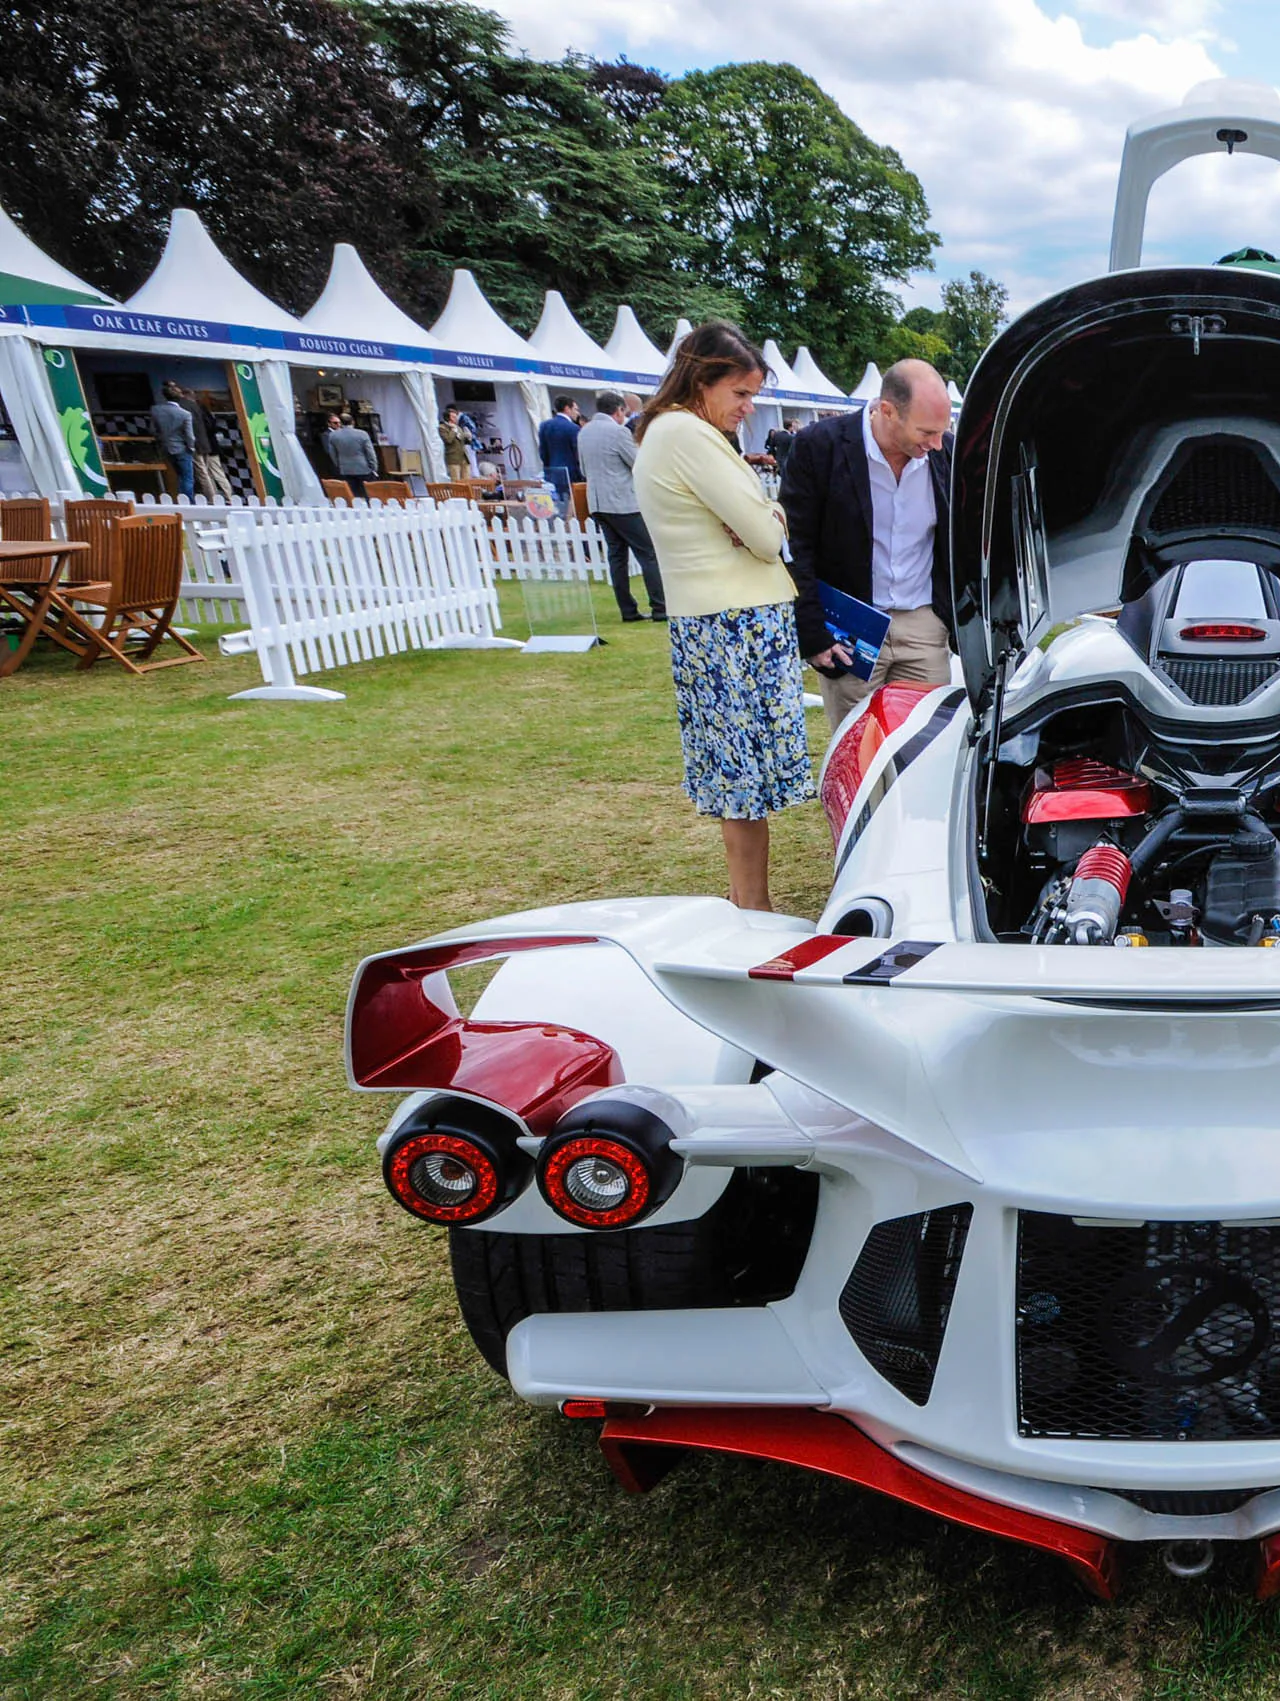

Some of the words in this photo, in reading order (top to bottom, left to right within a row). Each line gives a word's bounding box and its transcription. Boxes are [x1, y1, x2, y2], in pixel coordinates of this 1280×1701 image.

[92, 313, 126, 330] OAK
[129, 318, 163, 334] LEAF
[167, 322, 209, 338] GATES
[299, 337, 347, 353] ROBUSTO
[349, 343, 385, 356] CIGARS
